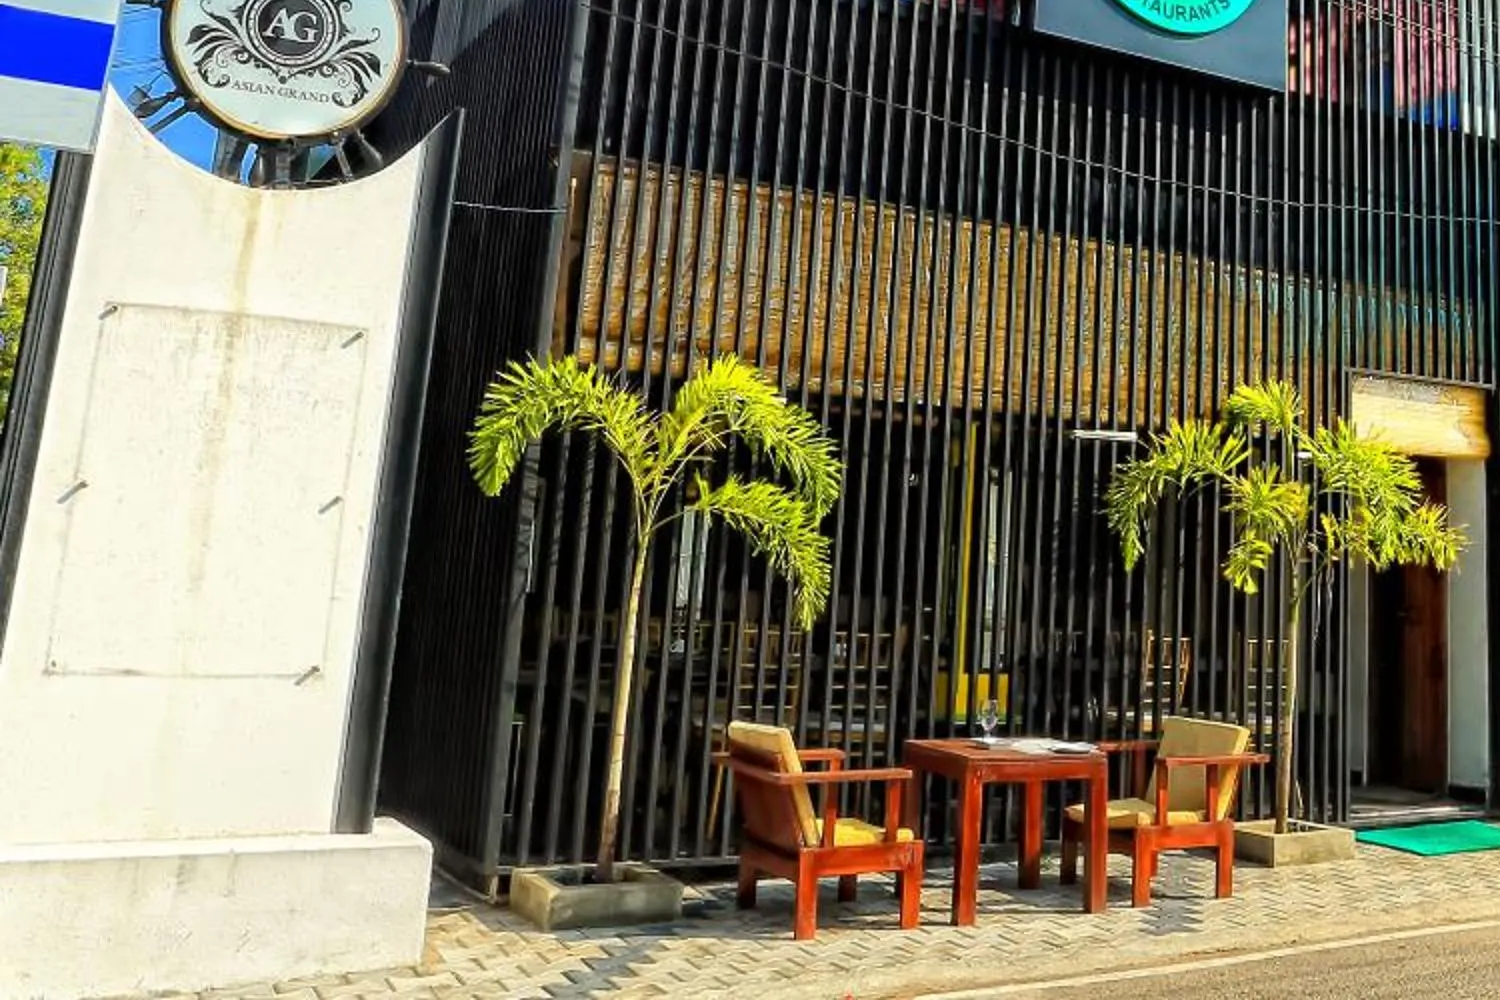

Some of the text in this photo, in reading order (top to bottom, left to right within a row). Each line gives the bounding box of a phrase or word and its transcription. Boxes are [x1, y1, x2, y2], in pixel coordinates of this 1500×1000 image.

[262, 7, 319, 44] AG
[231, 79, 329, 103] ASIAN GRAND
